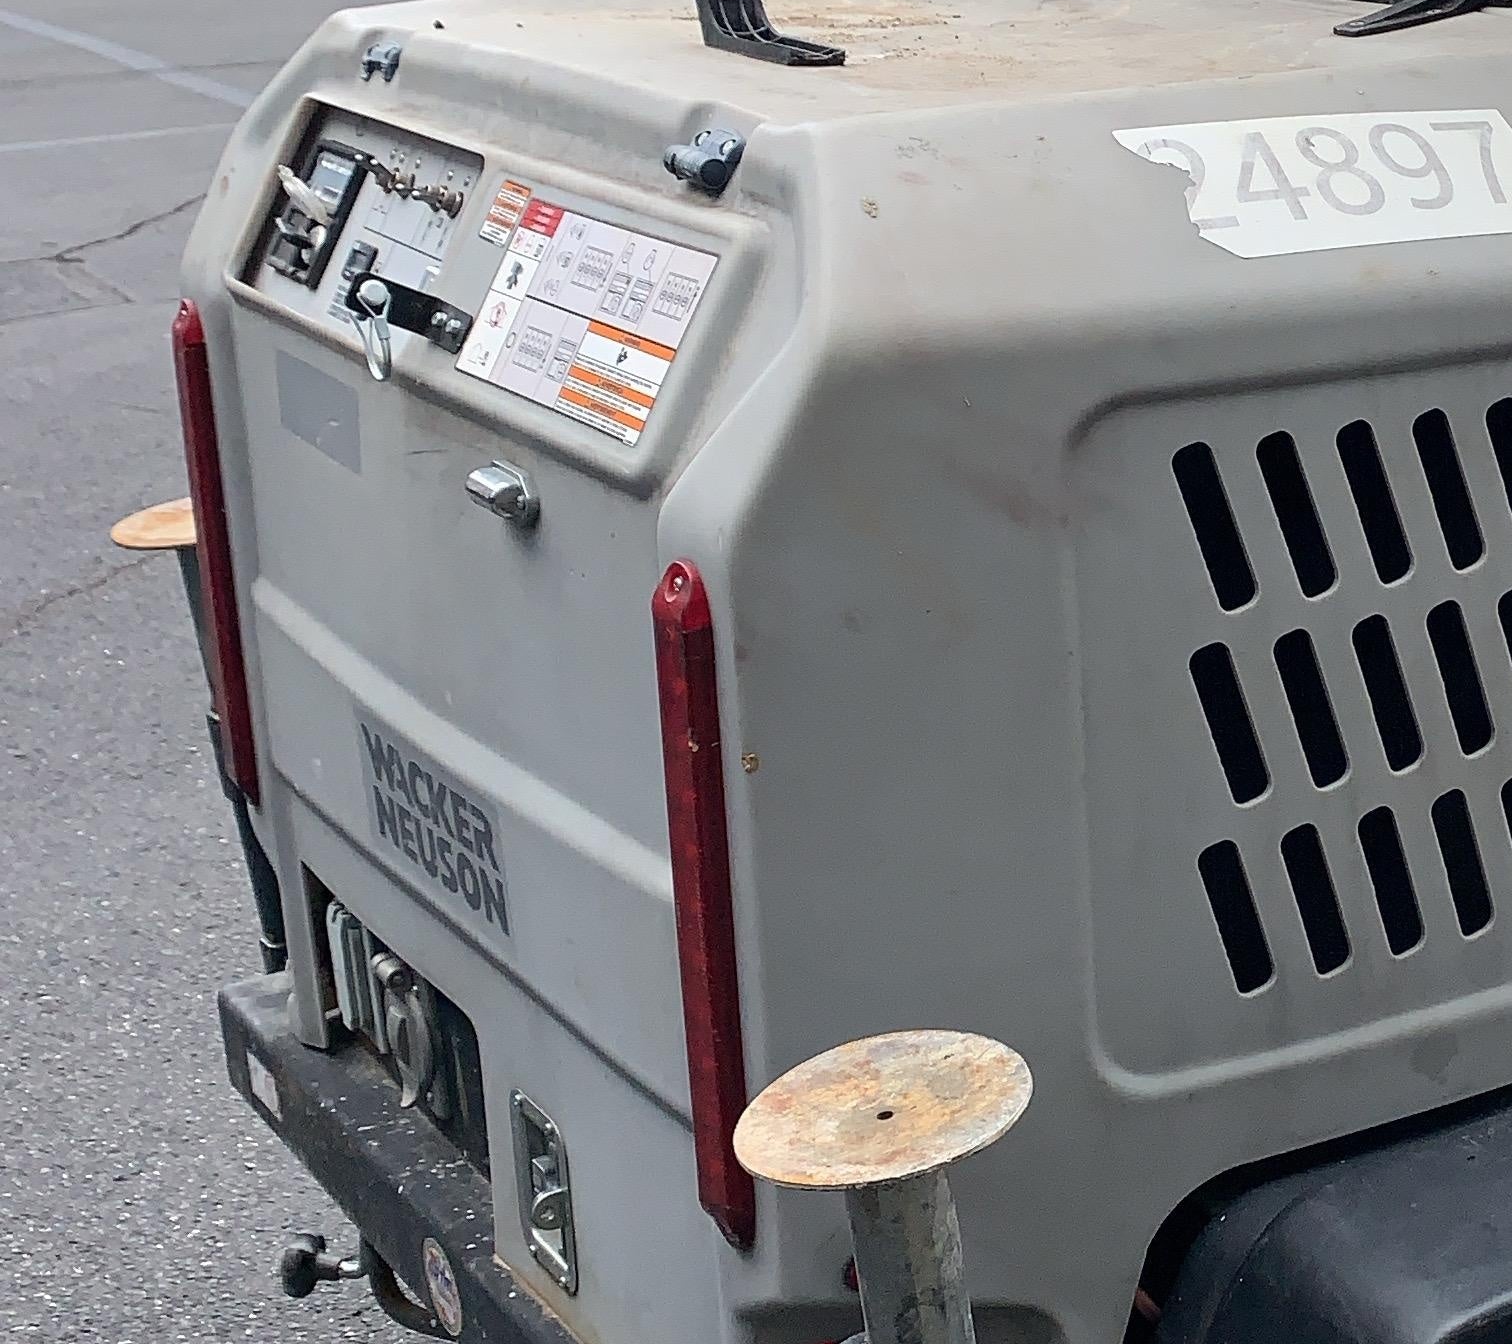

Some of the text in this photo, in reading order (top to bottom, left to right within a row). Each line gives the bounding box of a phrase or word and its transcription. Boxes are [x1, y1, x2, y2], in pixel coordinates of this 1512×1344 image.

[1136, 120, 1508, 231] 24897
[360, 722, 499, 873] WACKER
[373, 784, 510, 937] NEUSON
